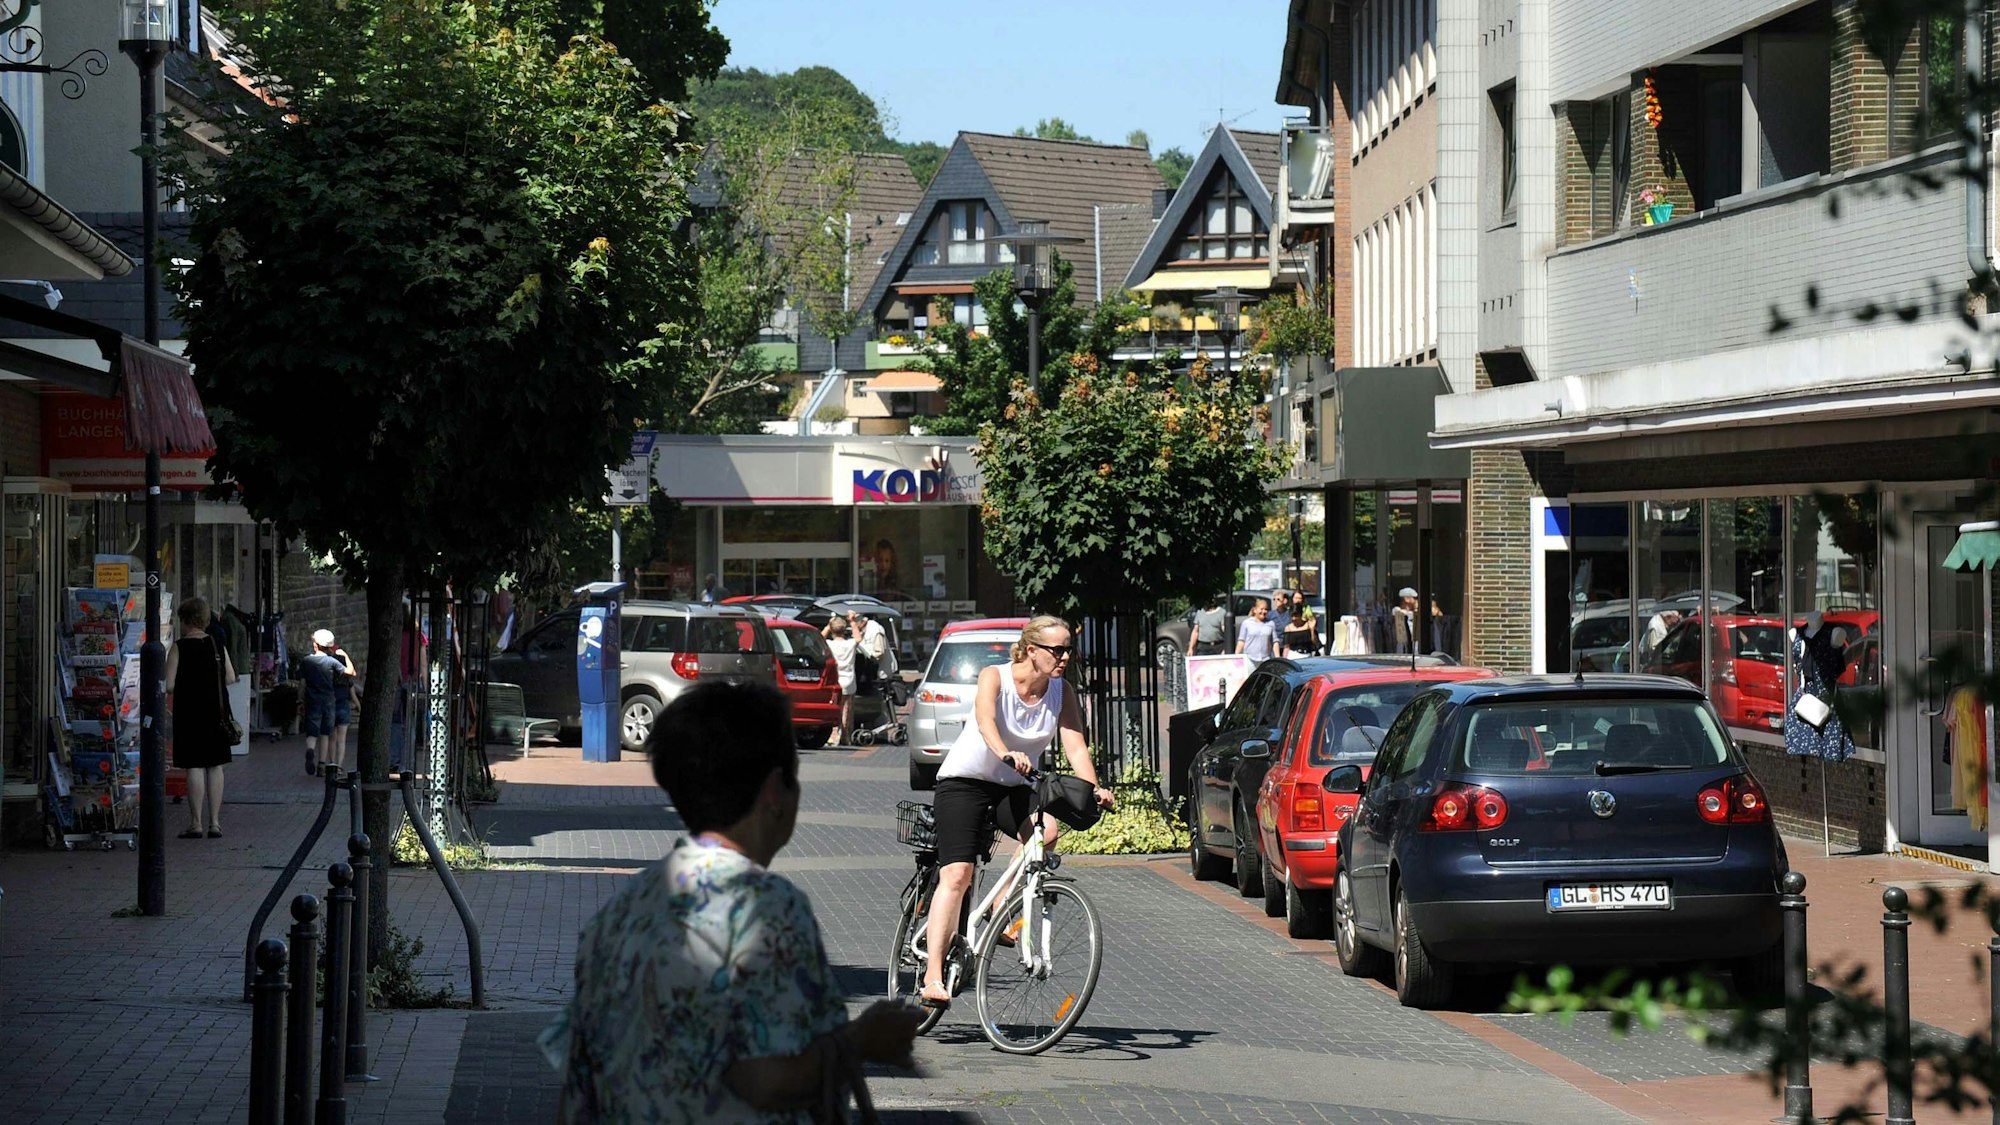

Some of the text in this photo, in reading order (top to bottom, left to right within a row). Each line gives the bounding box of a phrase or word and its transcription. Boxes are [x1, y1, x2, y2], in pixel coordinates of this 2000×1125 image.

[57, 407, 124, 421] BUCHHA
[58, 469, 196, 479] www.buchhandlunngen.de
[946, 473, 979, 490] esser
[946, 492, 982, 502] AUSHALT
[609, 600, 618, 615] P
[1489, 838, 1521, 847] GOLF
[1562, 884, 1587, 904] GL
[1601, 883, 1626, 902] HS
[1630, 883, 1666, 902] 470
